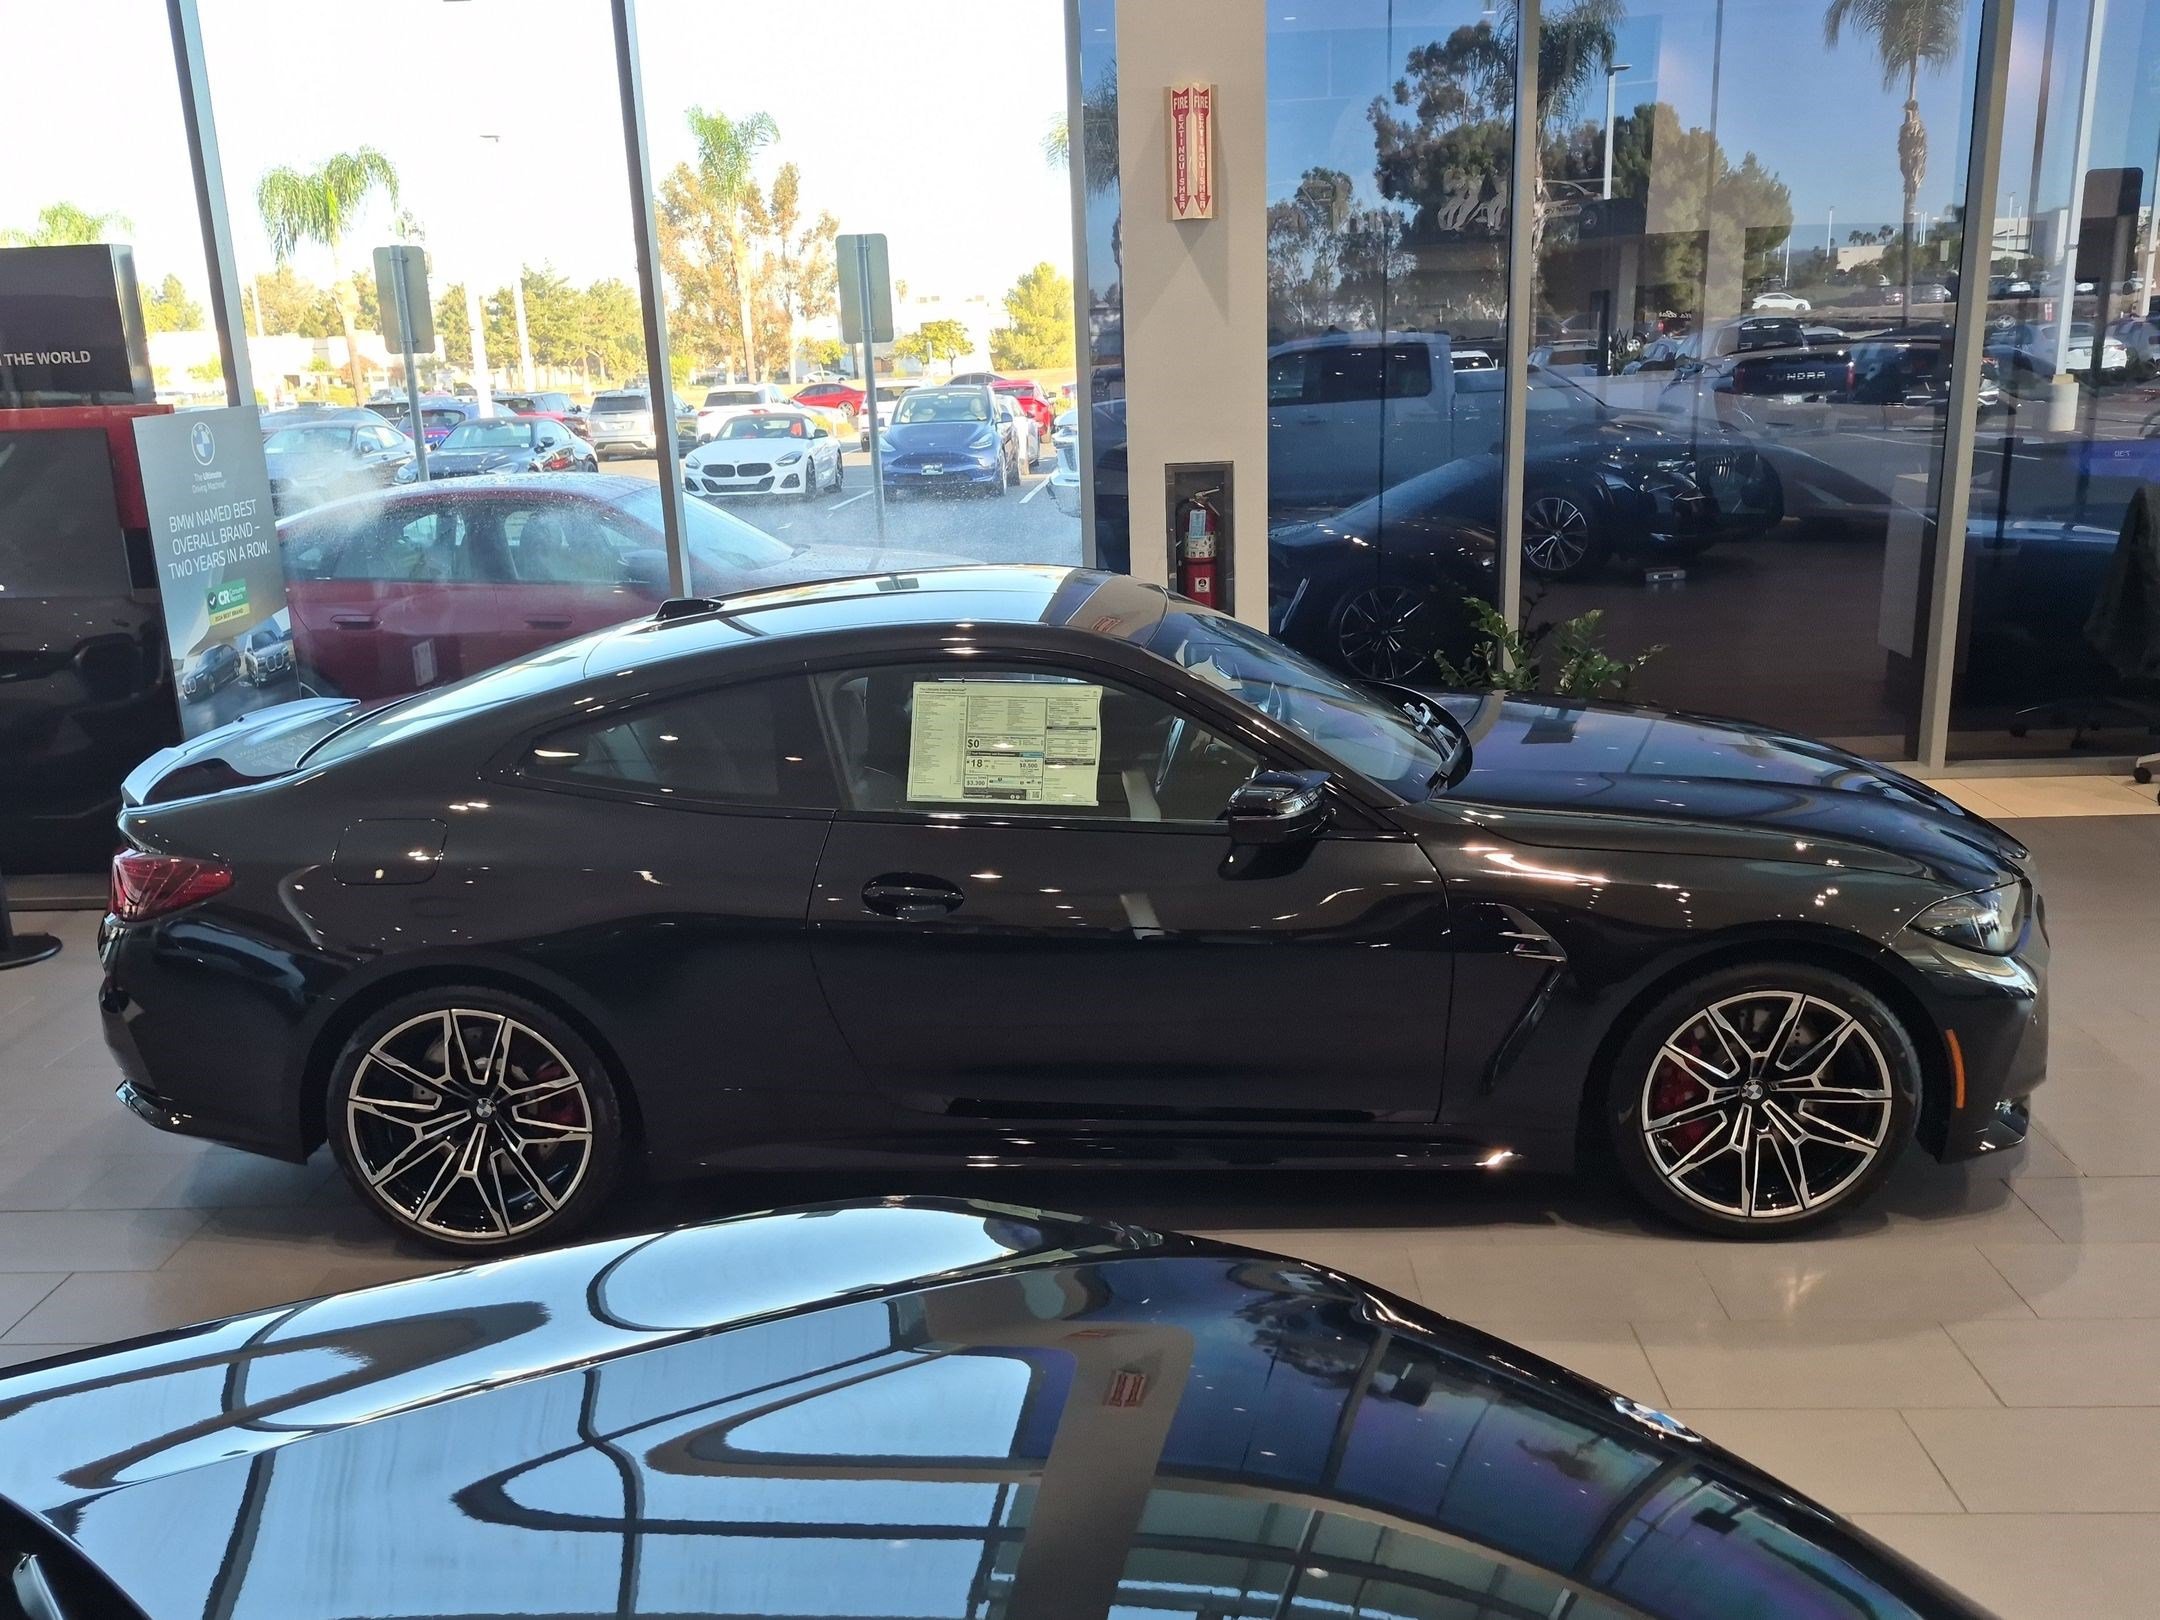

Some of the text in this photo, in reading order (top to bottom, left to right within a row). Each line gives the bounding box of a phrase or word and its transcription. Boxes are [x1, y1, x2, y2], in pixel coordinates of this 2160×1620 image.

[1173, 96, 1188, 110] FIRE
[1194, 95, 1208, 109] FIRE
[1178, 114, 1186, 209] EXTINGUISHER
[1198, 113, 1206, 208] EXTINGUISHER
[3, 352, 35, 366] THE
[36, 350, 91, 365] WORLD
[169, 499, 257, 533] BMW NAMED BEST
[172, 531, 219, 555] OVERALL
[219, 521, 253, 544] BRAND
[168, 539, 271, 580] TWO YEARS IN A ROW.
[218, 589, 231, 605] CR
[967, 739, 980, 748] $0
[971, 759, 983, 768] 18
